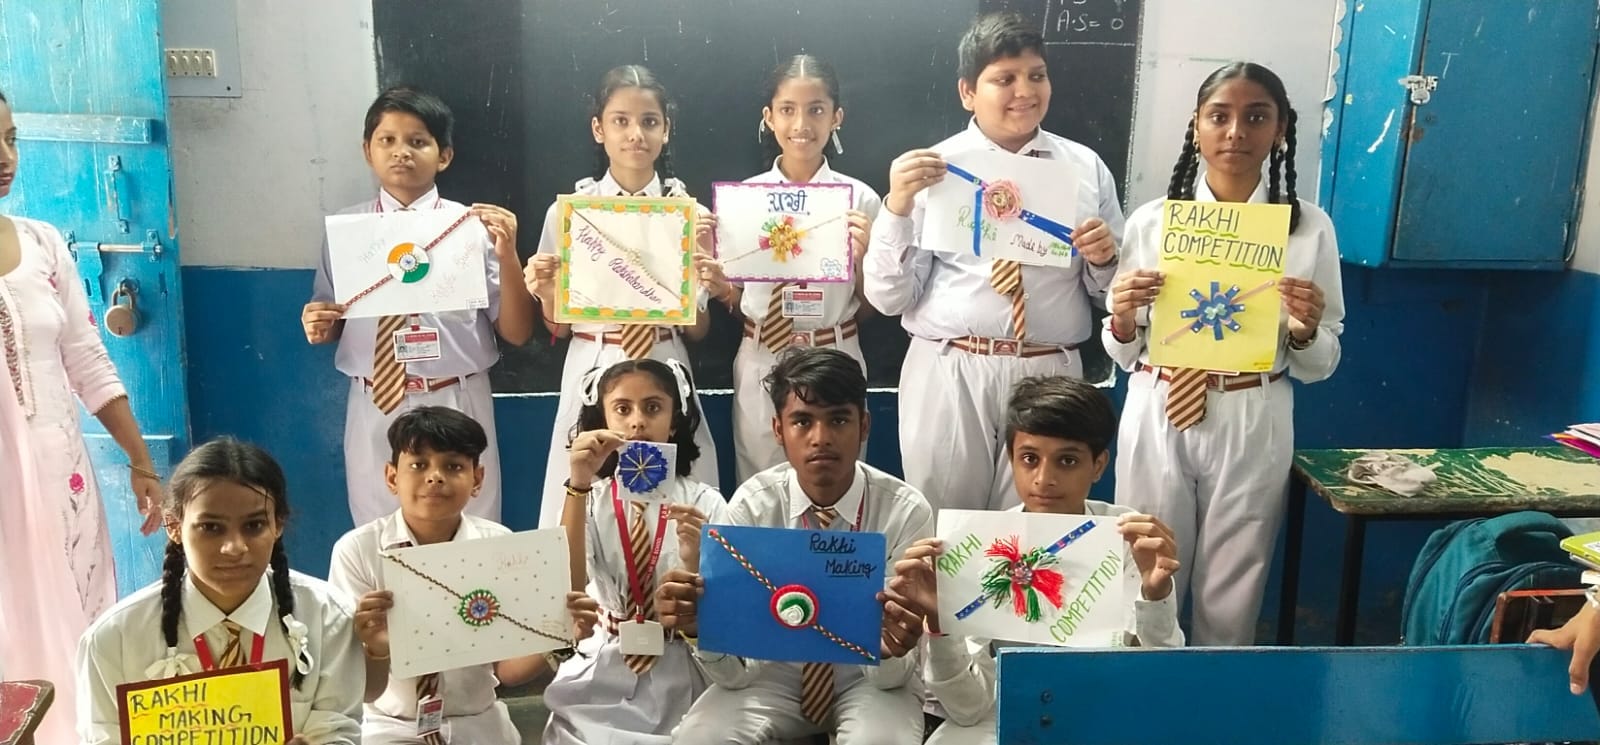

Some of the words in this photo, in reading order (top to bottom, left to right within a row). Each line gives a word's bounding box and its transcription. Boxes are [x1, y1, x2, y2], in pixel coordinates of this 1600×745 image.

[1169, 203, 1240, 233] RAKHI
[576, 225, 605, 261] Happy
[1010, 233, 1034, 252] Made
[1036, 240, 1048, 257] by
[1164, 232, 1284, 269] COMPETITION
[809, 532, 856, 553] Rakhi
[937, 533, 982, 577] RAKHI
[825, 557, 877, 579] Making
[1050, 550, 1121, 643] COMPETITION
[130, 682, 207, 713] RAKHI
[159, 705, 252, 729] MAKING
